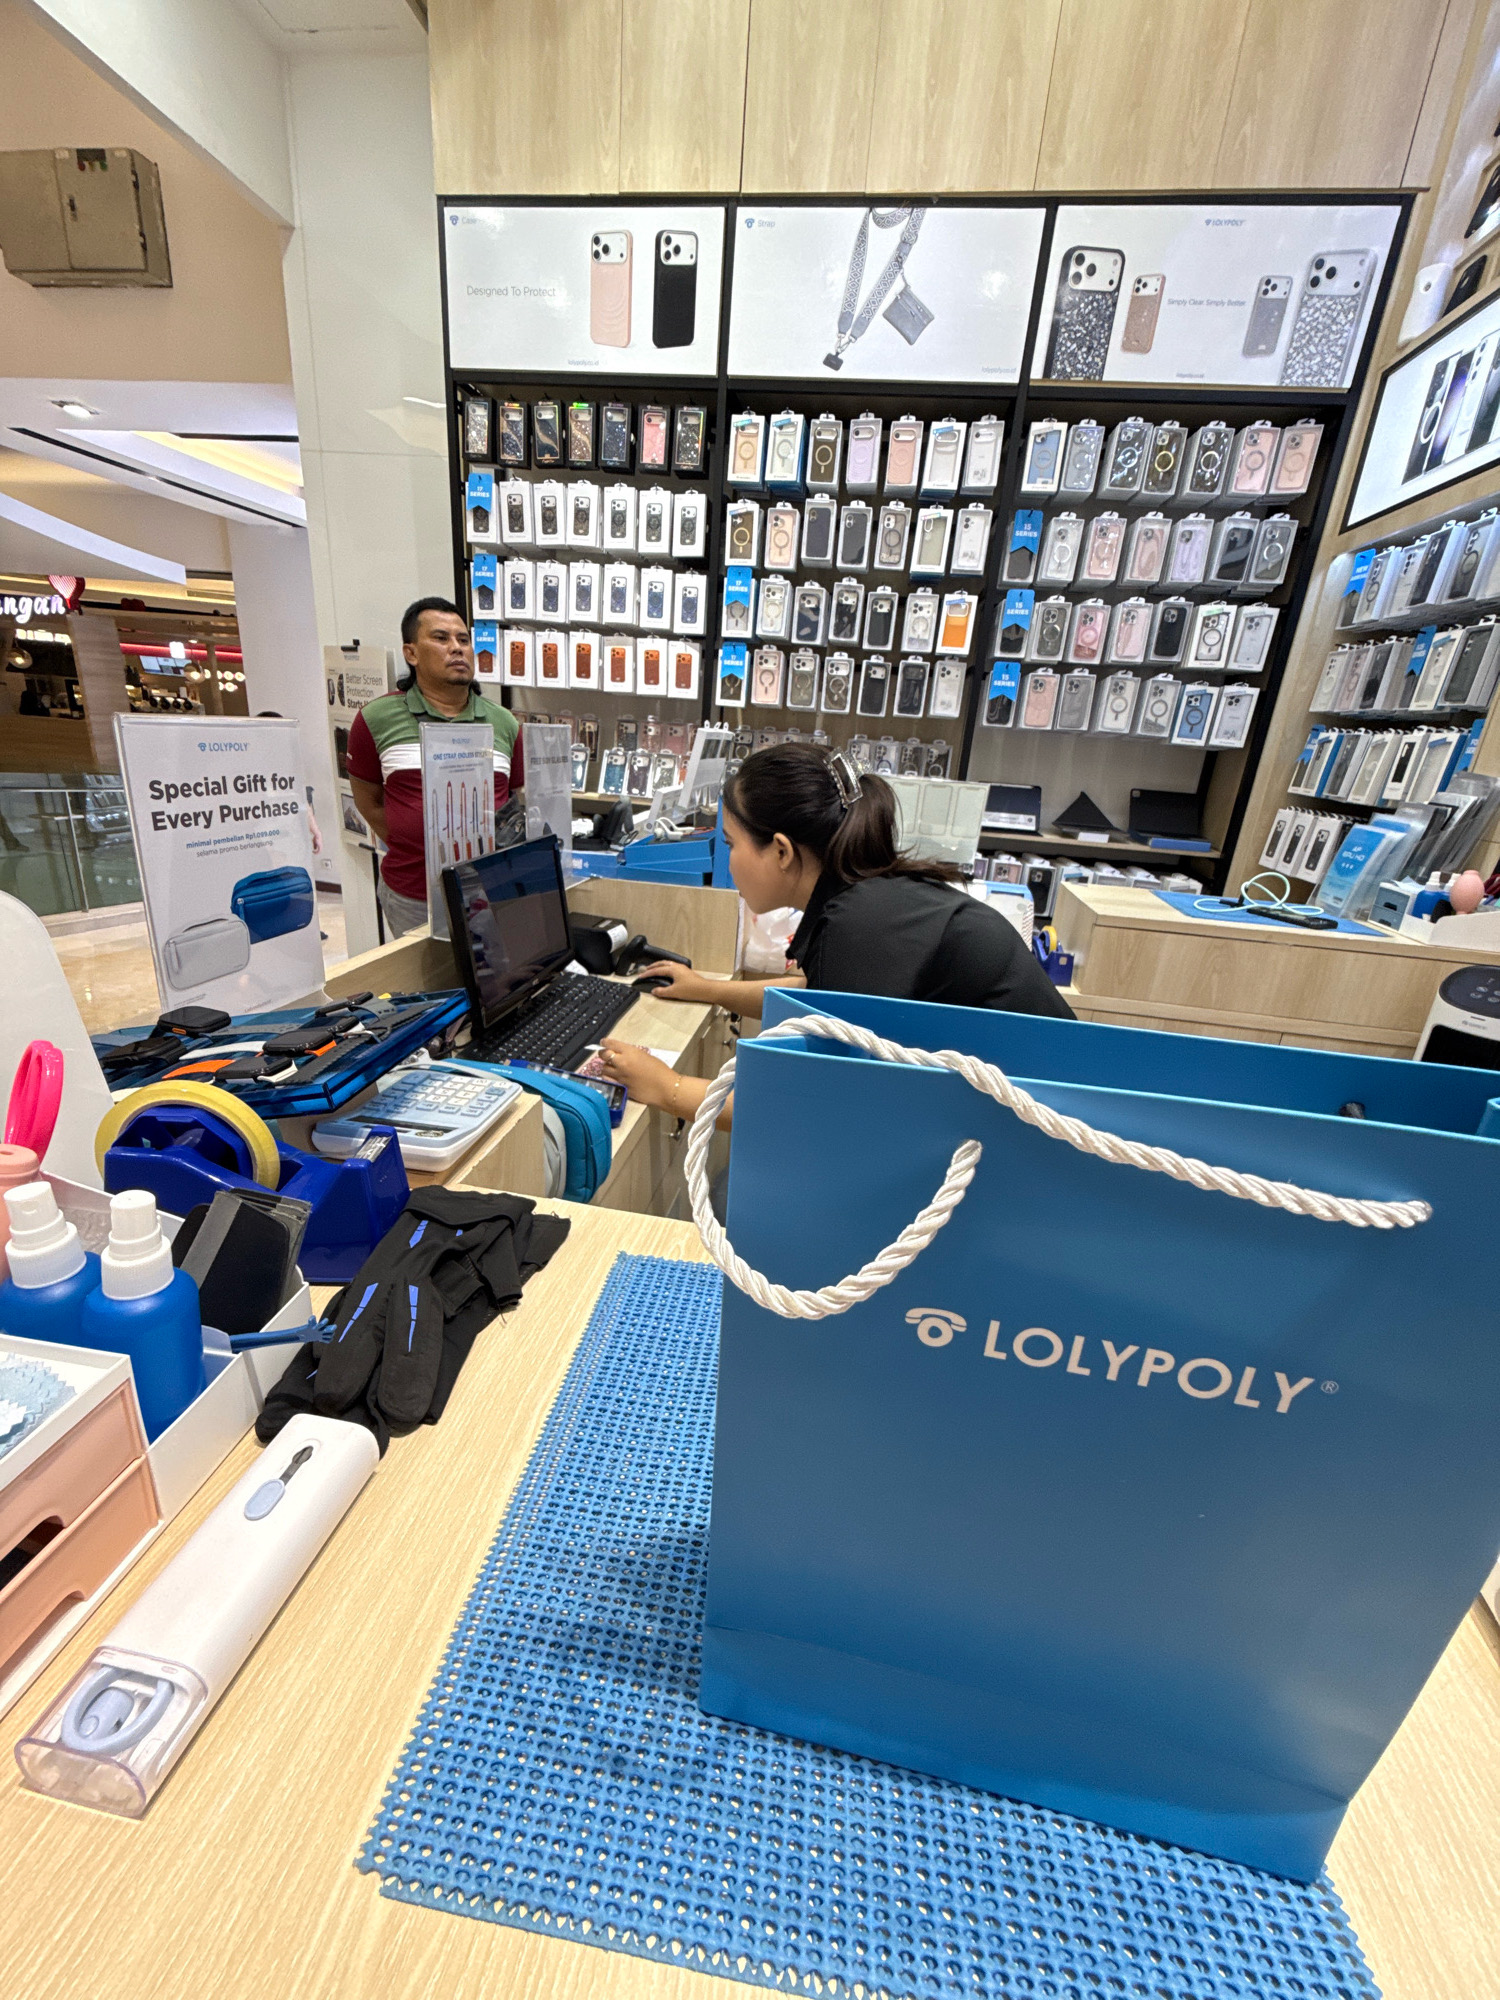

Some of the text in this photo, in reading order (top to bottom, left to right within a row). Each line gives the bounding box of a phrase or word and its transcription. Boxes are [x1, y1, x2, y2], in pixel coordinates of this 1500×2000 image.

[757, 219, 776, 228] Strap
[466, 285, 556, 297] Designed To Protect
[1024, 523, 1032, 531] 15
[1015, 530, 1038, 538] SERIES
[0, 594, 66, 624] ngan
[1015, 601, 1023, 609] 15
[1006, 608, 1029, 616] SERIES
[345, 673, 383, 686] Better Screen
[1002, 673, 1010, 681] 15
[993, 680, 1015, 688] SERIES
[346, 685, 374, 698] Protection
[208, 742, 248, 752] LOLYPOLY
[149, 773, 295, 803] Special Gift for
[151, 800, 299, 831] Every Purchase
[186, 838, 212, 849] minimal
[213, 834, 245, 846] pembelian
[196, 839, 273, 858] selama promo berlangsung
[983, 1319, 1316, 1414] LOLYPOLY
